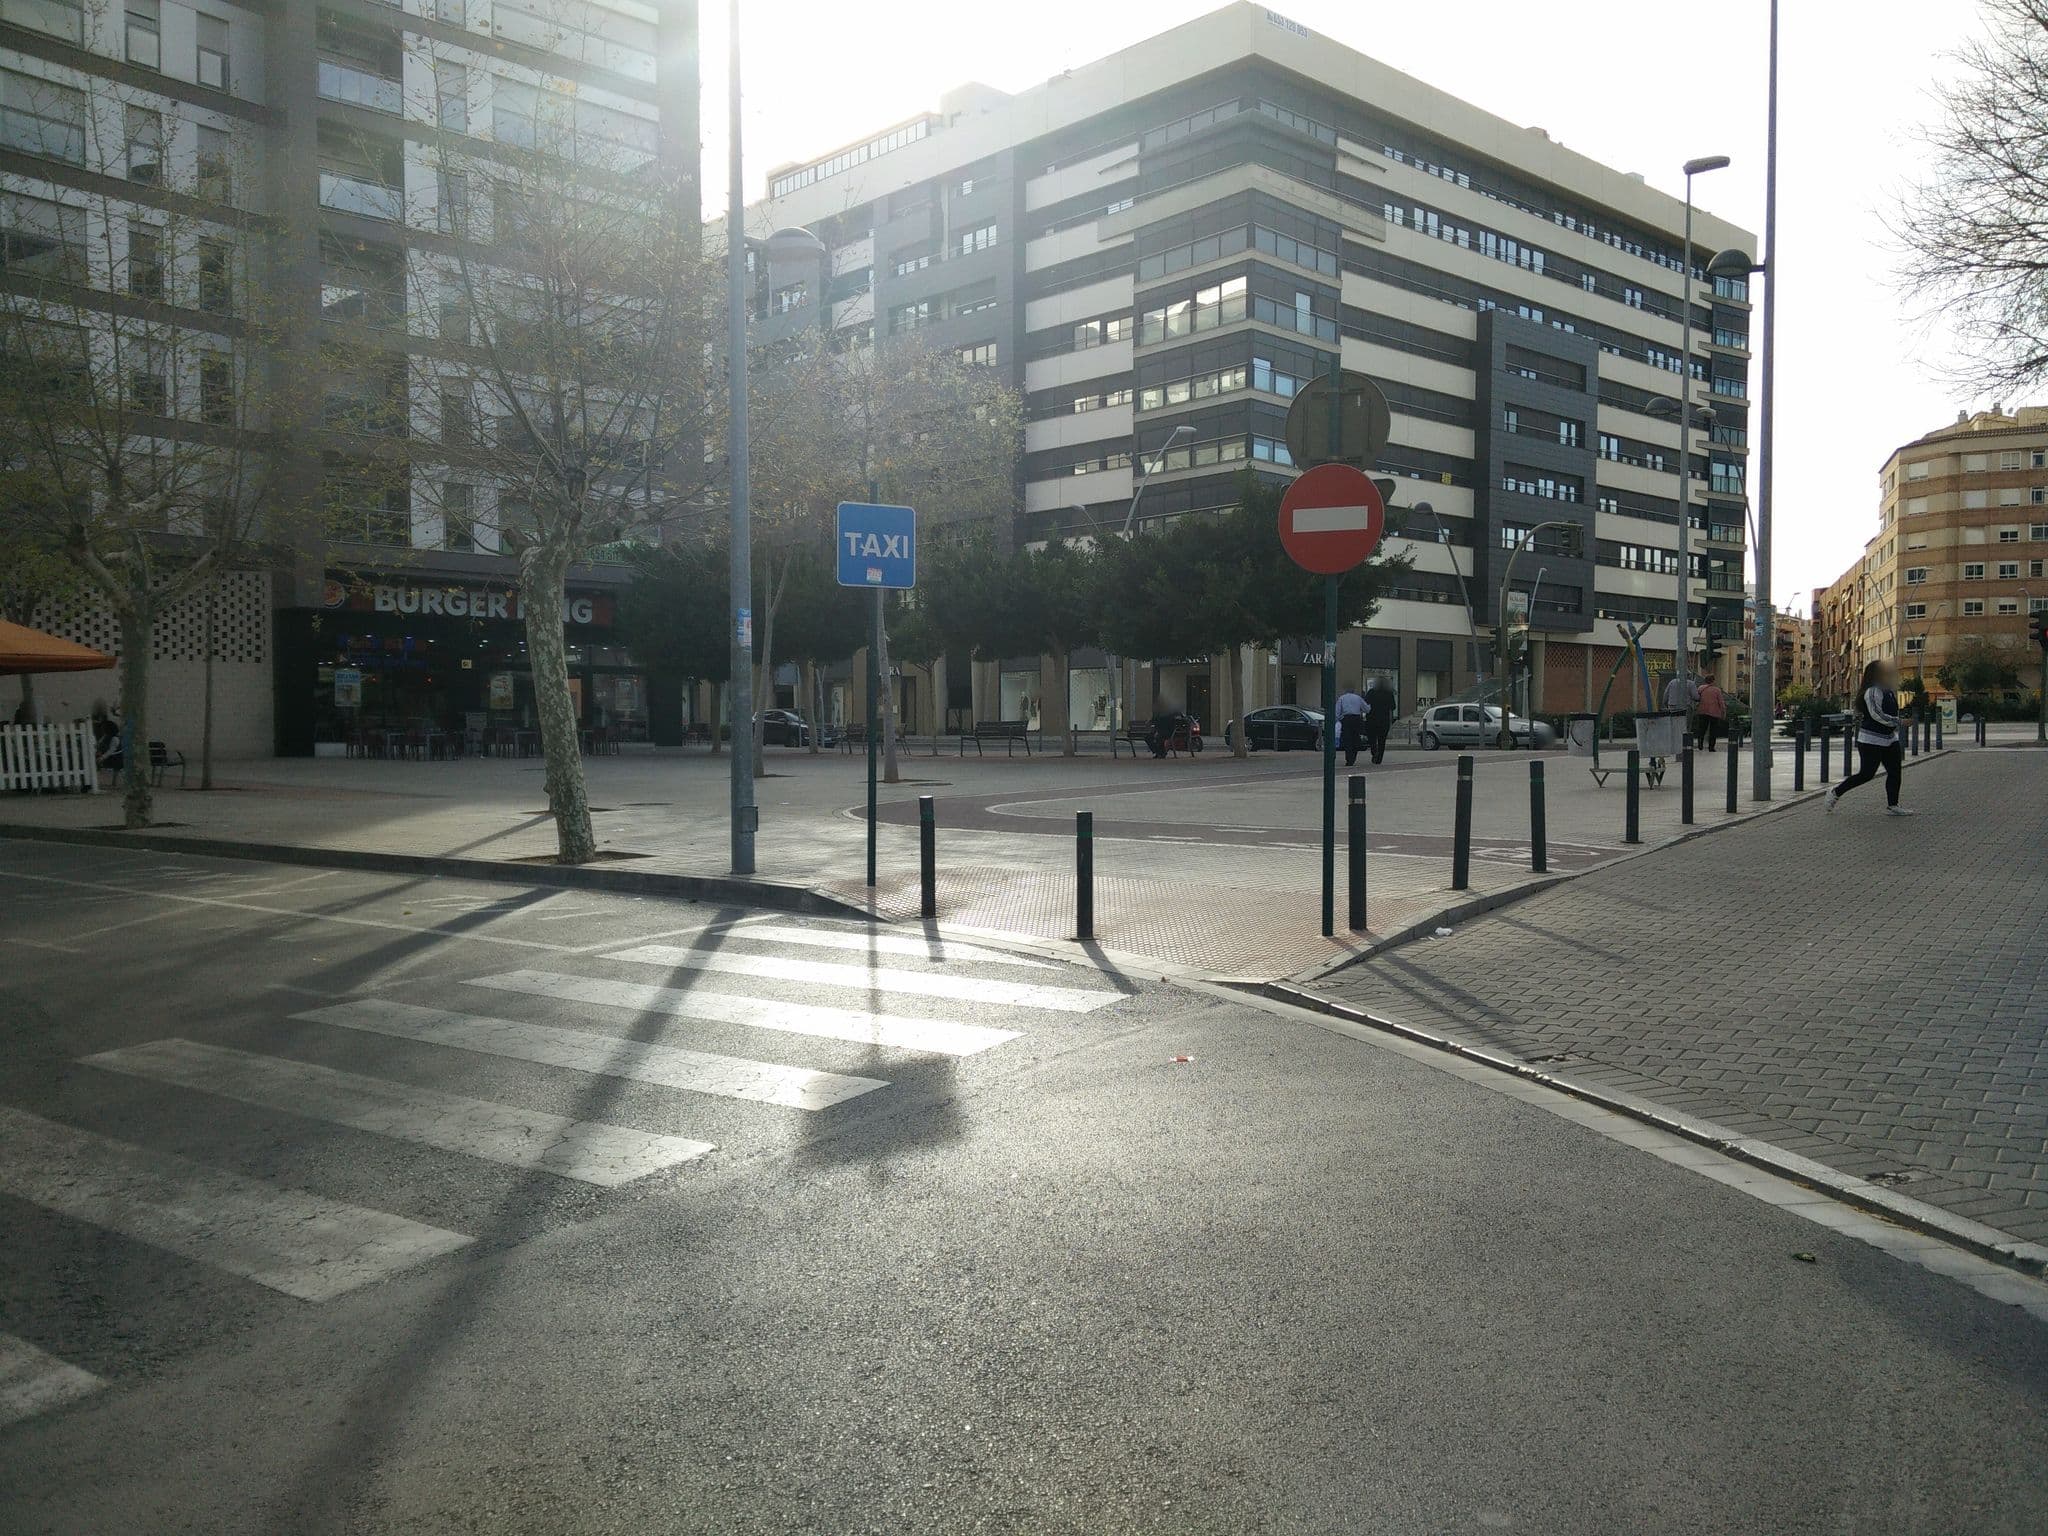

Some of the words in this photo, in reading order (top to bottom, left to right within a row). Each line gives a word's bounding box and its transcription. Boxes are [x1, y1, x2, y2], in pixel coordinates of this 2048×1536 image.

[844, 531, 909, 559] TAXI
[374, 584, 508, 619] BURGER
[1303, 652, 1327, 665] ZAR
